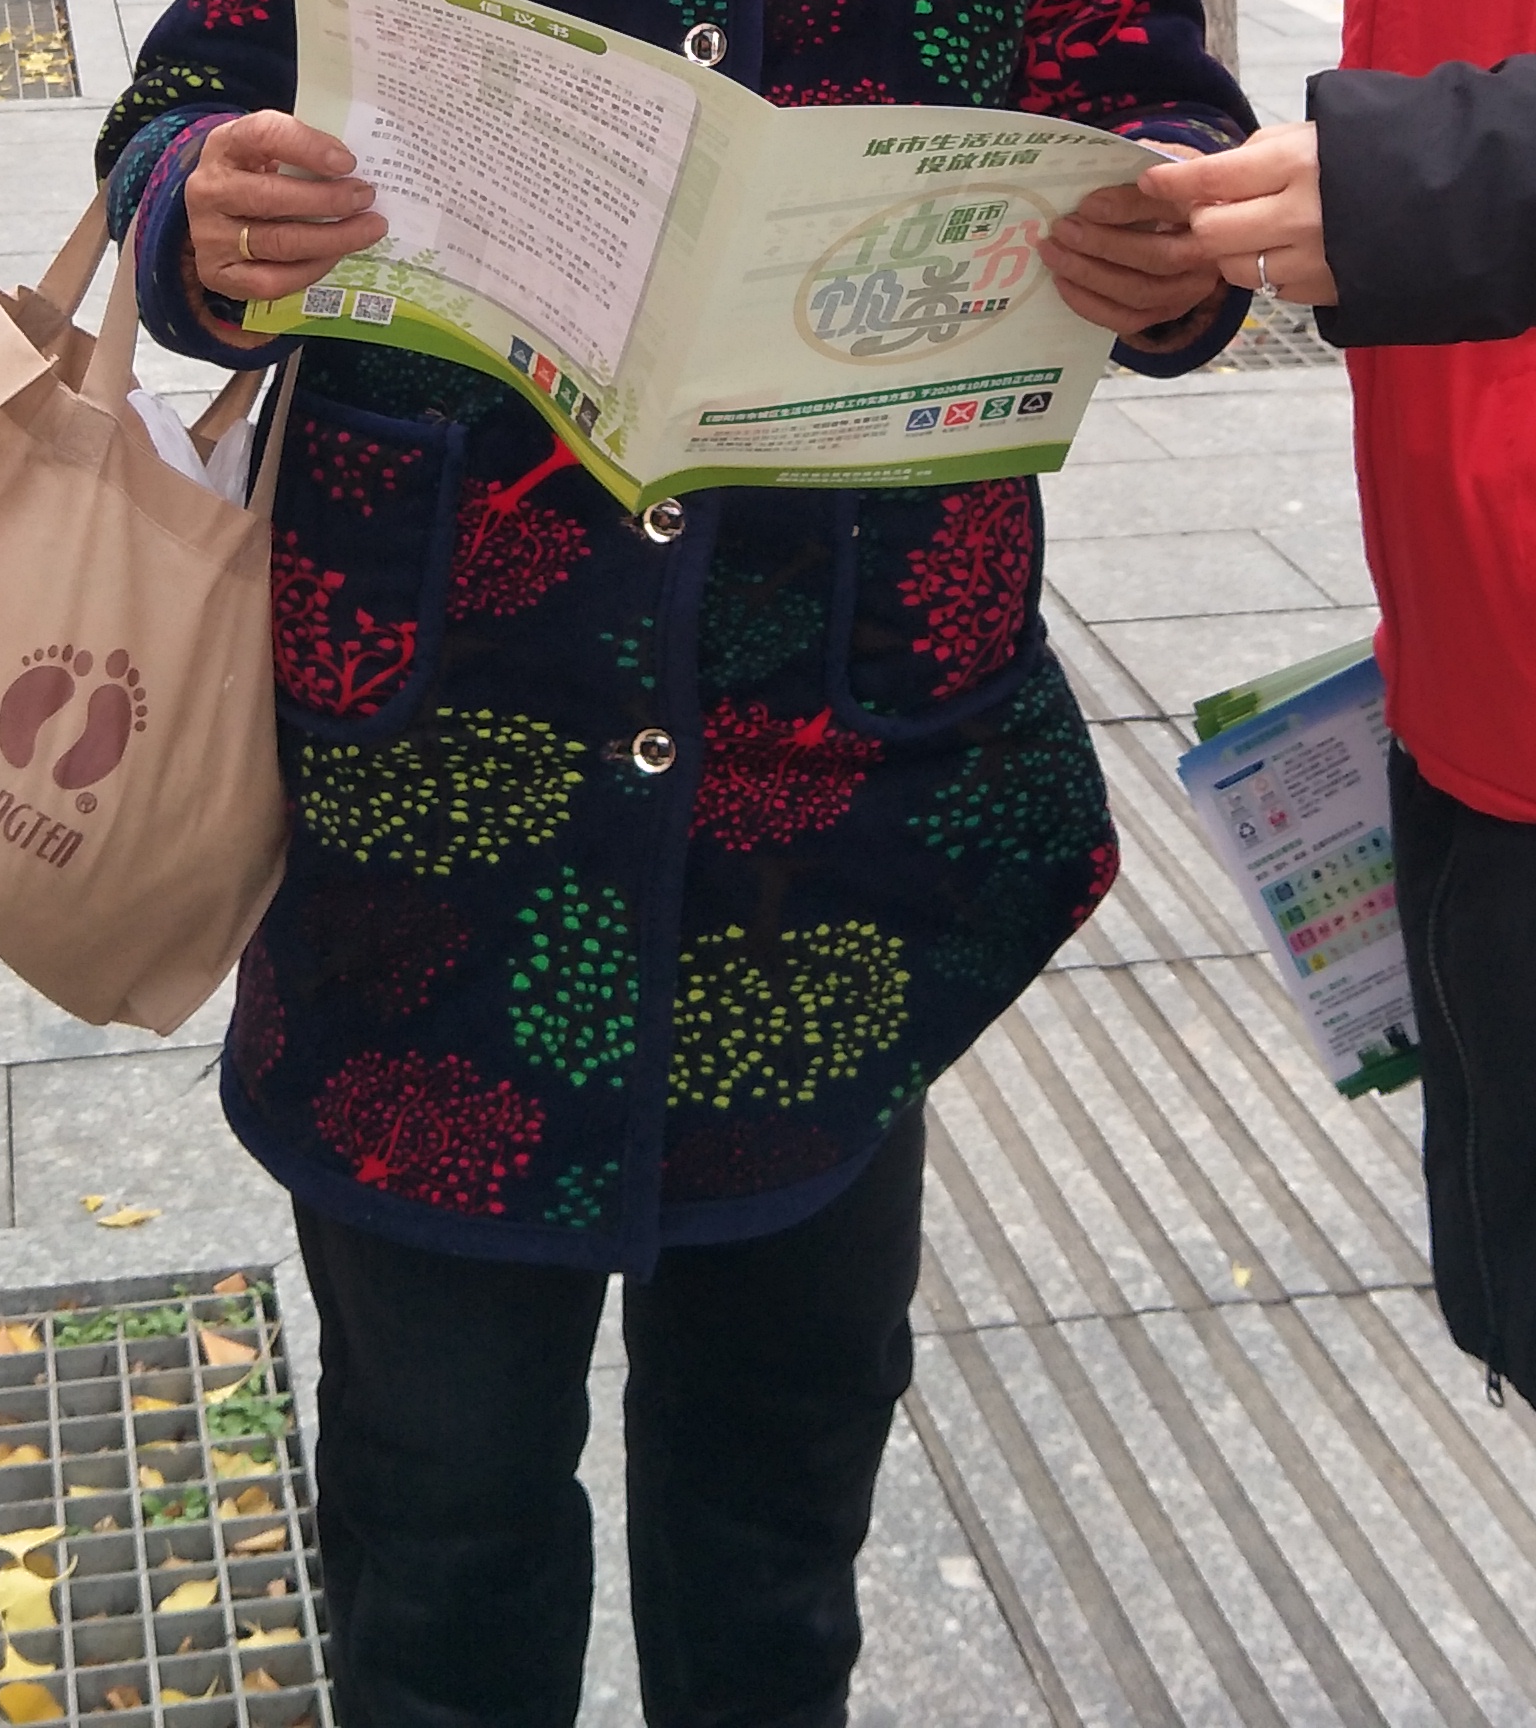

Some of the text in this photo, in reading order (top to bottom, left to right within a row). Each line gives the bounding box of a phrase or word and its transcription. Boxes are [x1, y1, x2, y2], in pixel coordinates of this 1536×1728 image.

[478, 0, 570, 39] 倡议书
[862, 131, 1118, 158] 城市生活垃圾分类
[914, 148, 1043, 175] 投放指南
